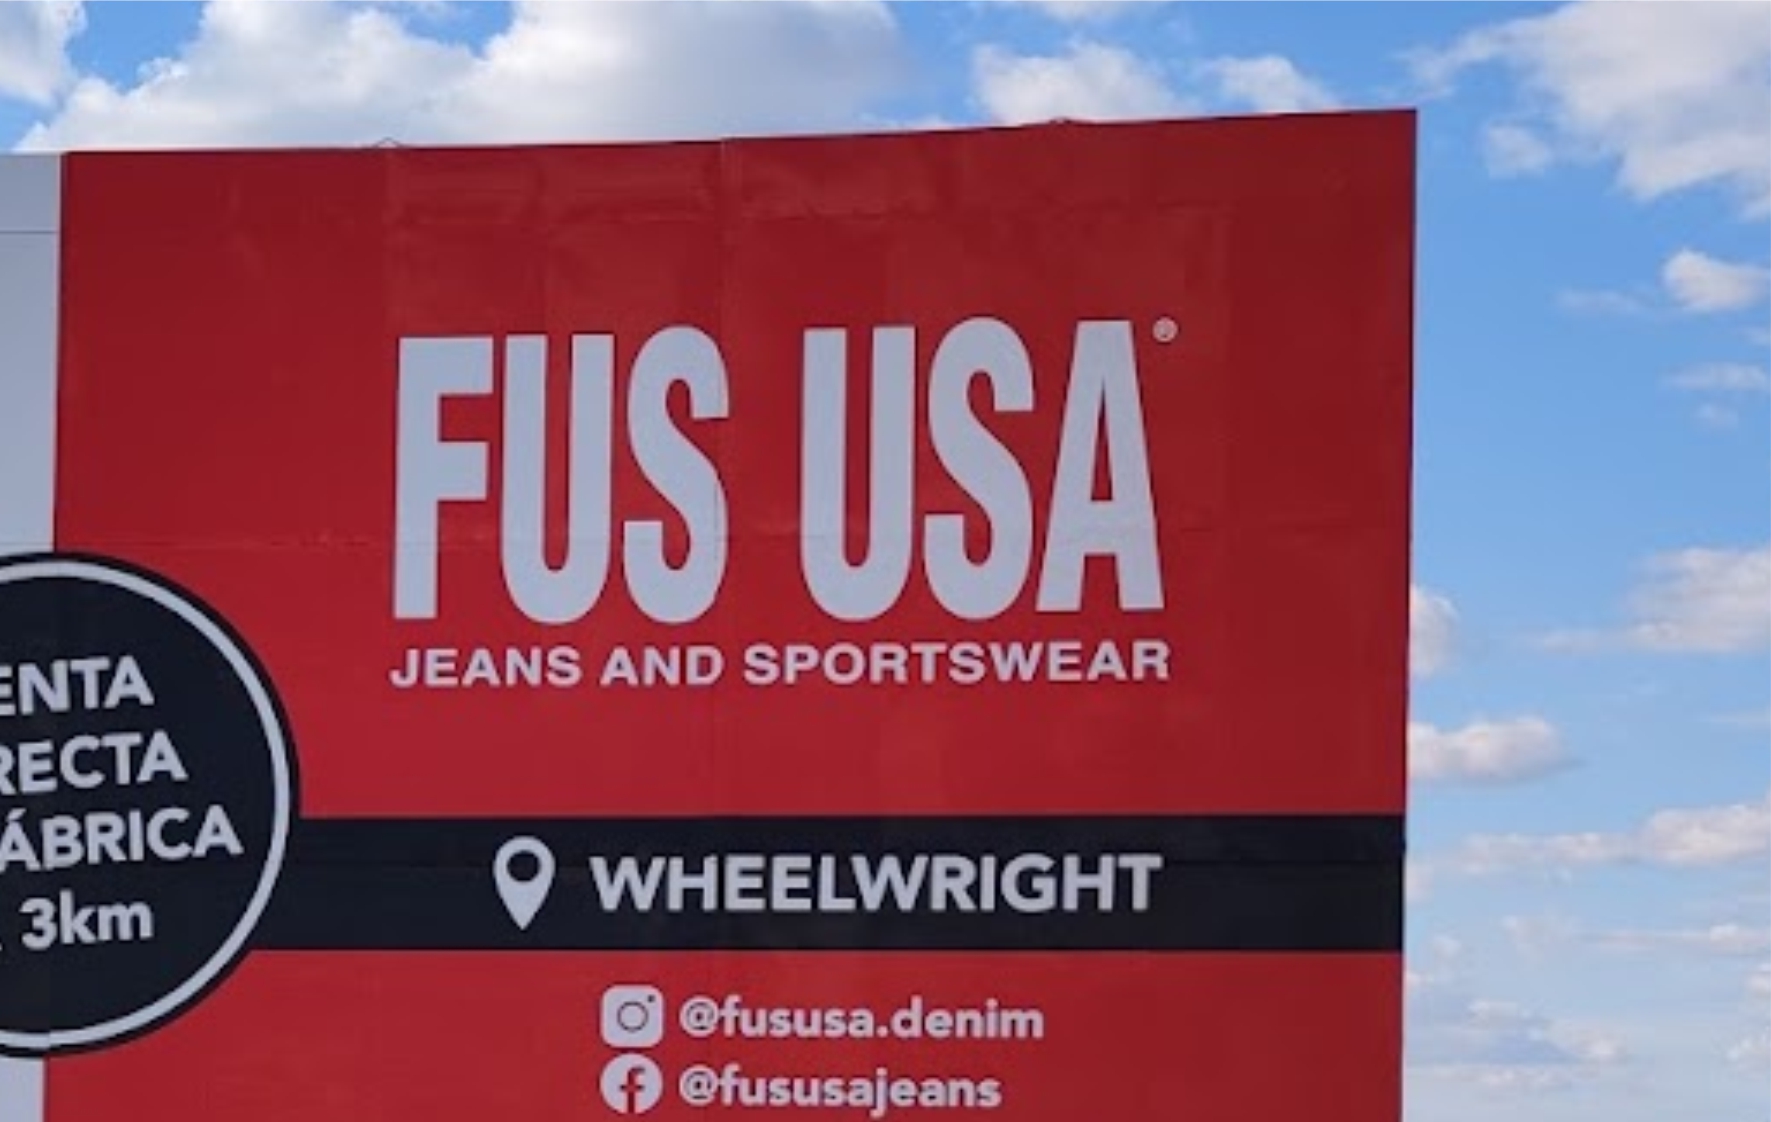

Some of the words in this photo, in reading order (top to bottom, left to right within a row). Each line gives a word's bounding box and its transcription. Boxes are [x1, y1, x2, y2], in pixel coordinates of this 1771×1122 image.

[394, 326, 729, 625] FUS
[800, 317, 1164, 621] USA
[390, 646, 582, 687] JEANS
[600, 646, 723, 686] AND
[744, 640, 1169, 685] SPORTSWEAR
[590, 853, 1162, 912] WHEELWRIGHT
[20, 890, 153, 950] 3km
[679, 994, 1044, 1038] @fususa.denim
[679, 1063, 1002, 1118] @fususajeans
